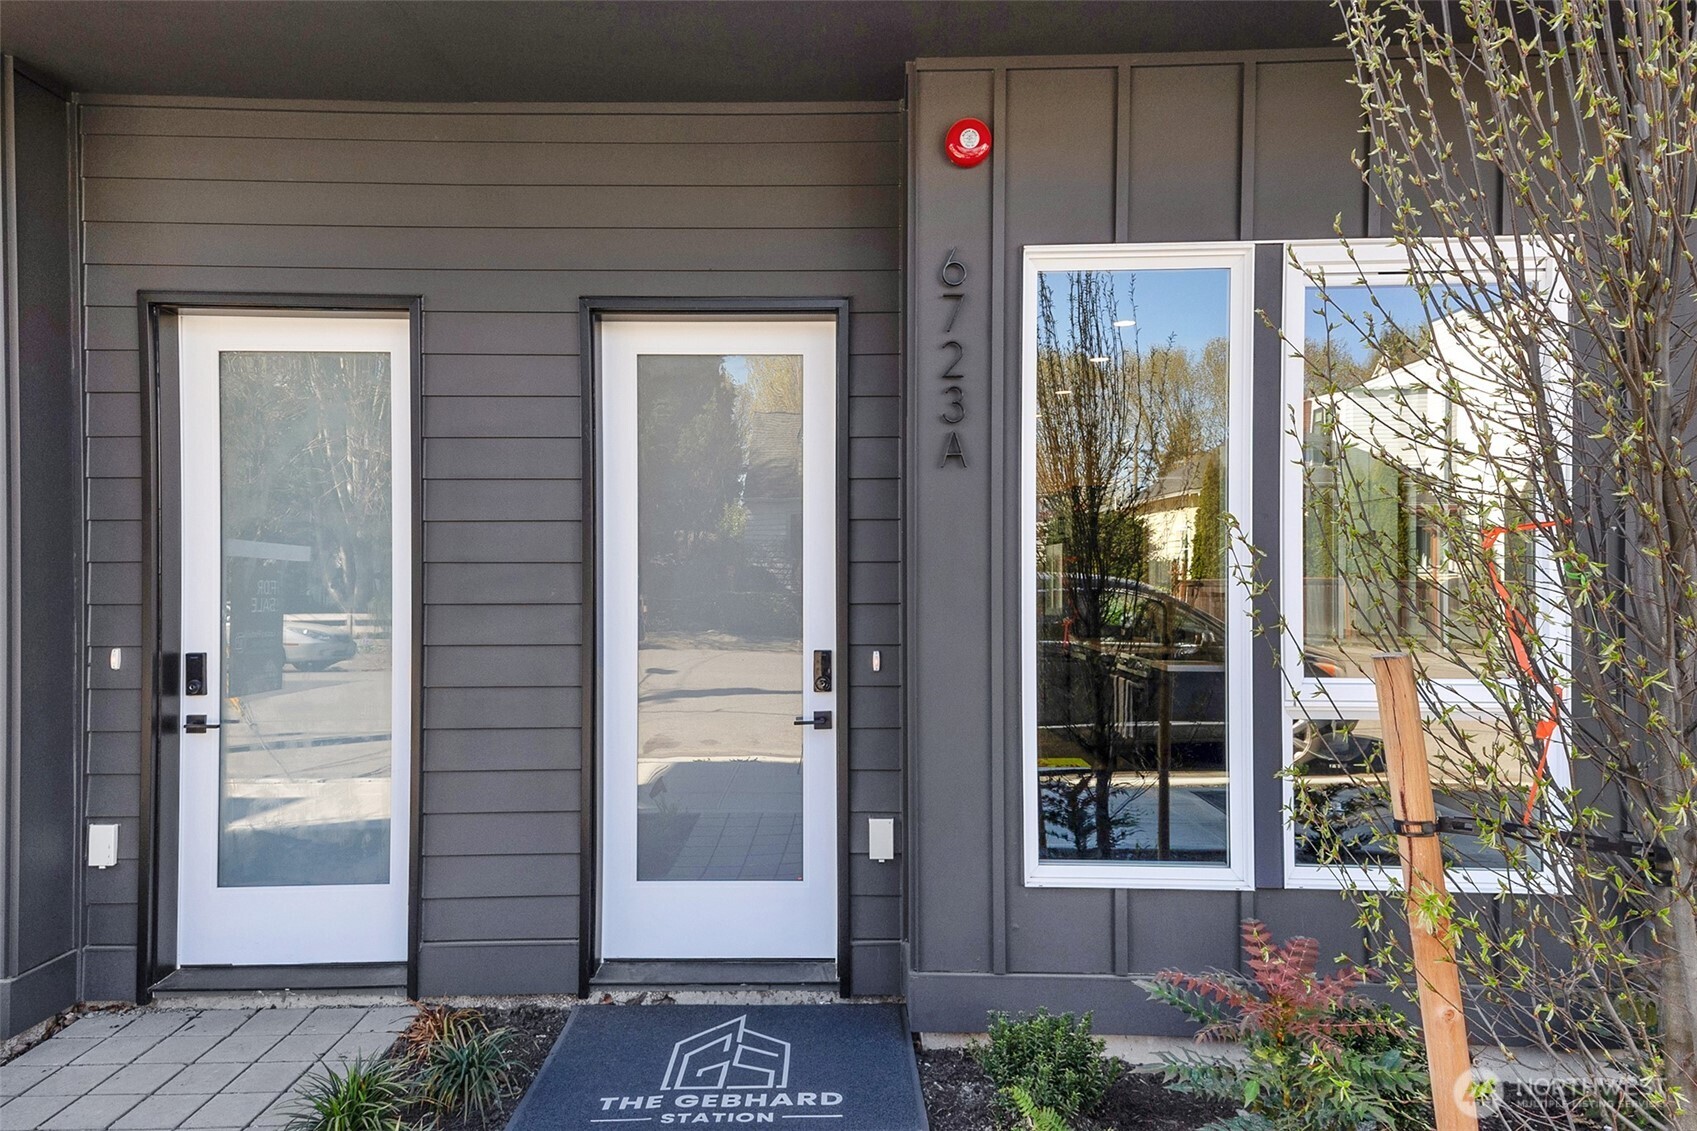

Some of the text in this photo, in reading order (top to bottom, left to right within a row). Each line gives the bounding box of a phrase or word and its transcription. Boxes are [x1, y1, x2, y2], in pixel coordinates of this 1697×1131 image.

[942, 247, 967, 468] 6723A
[600, 1092, 843, 1110] THE GEBHARD
[660, 1112, 774, 1124] STATION
